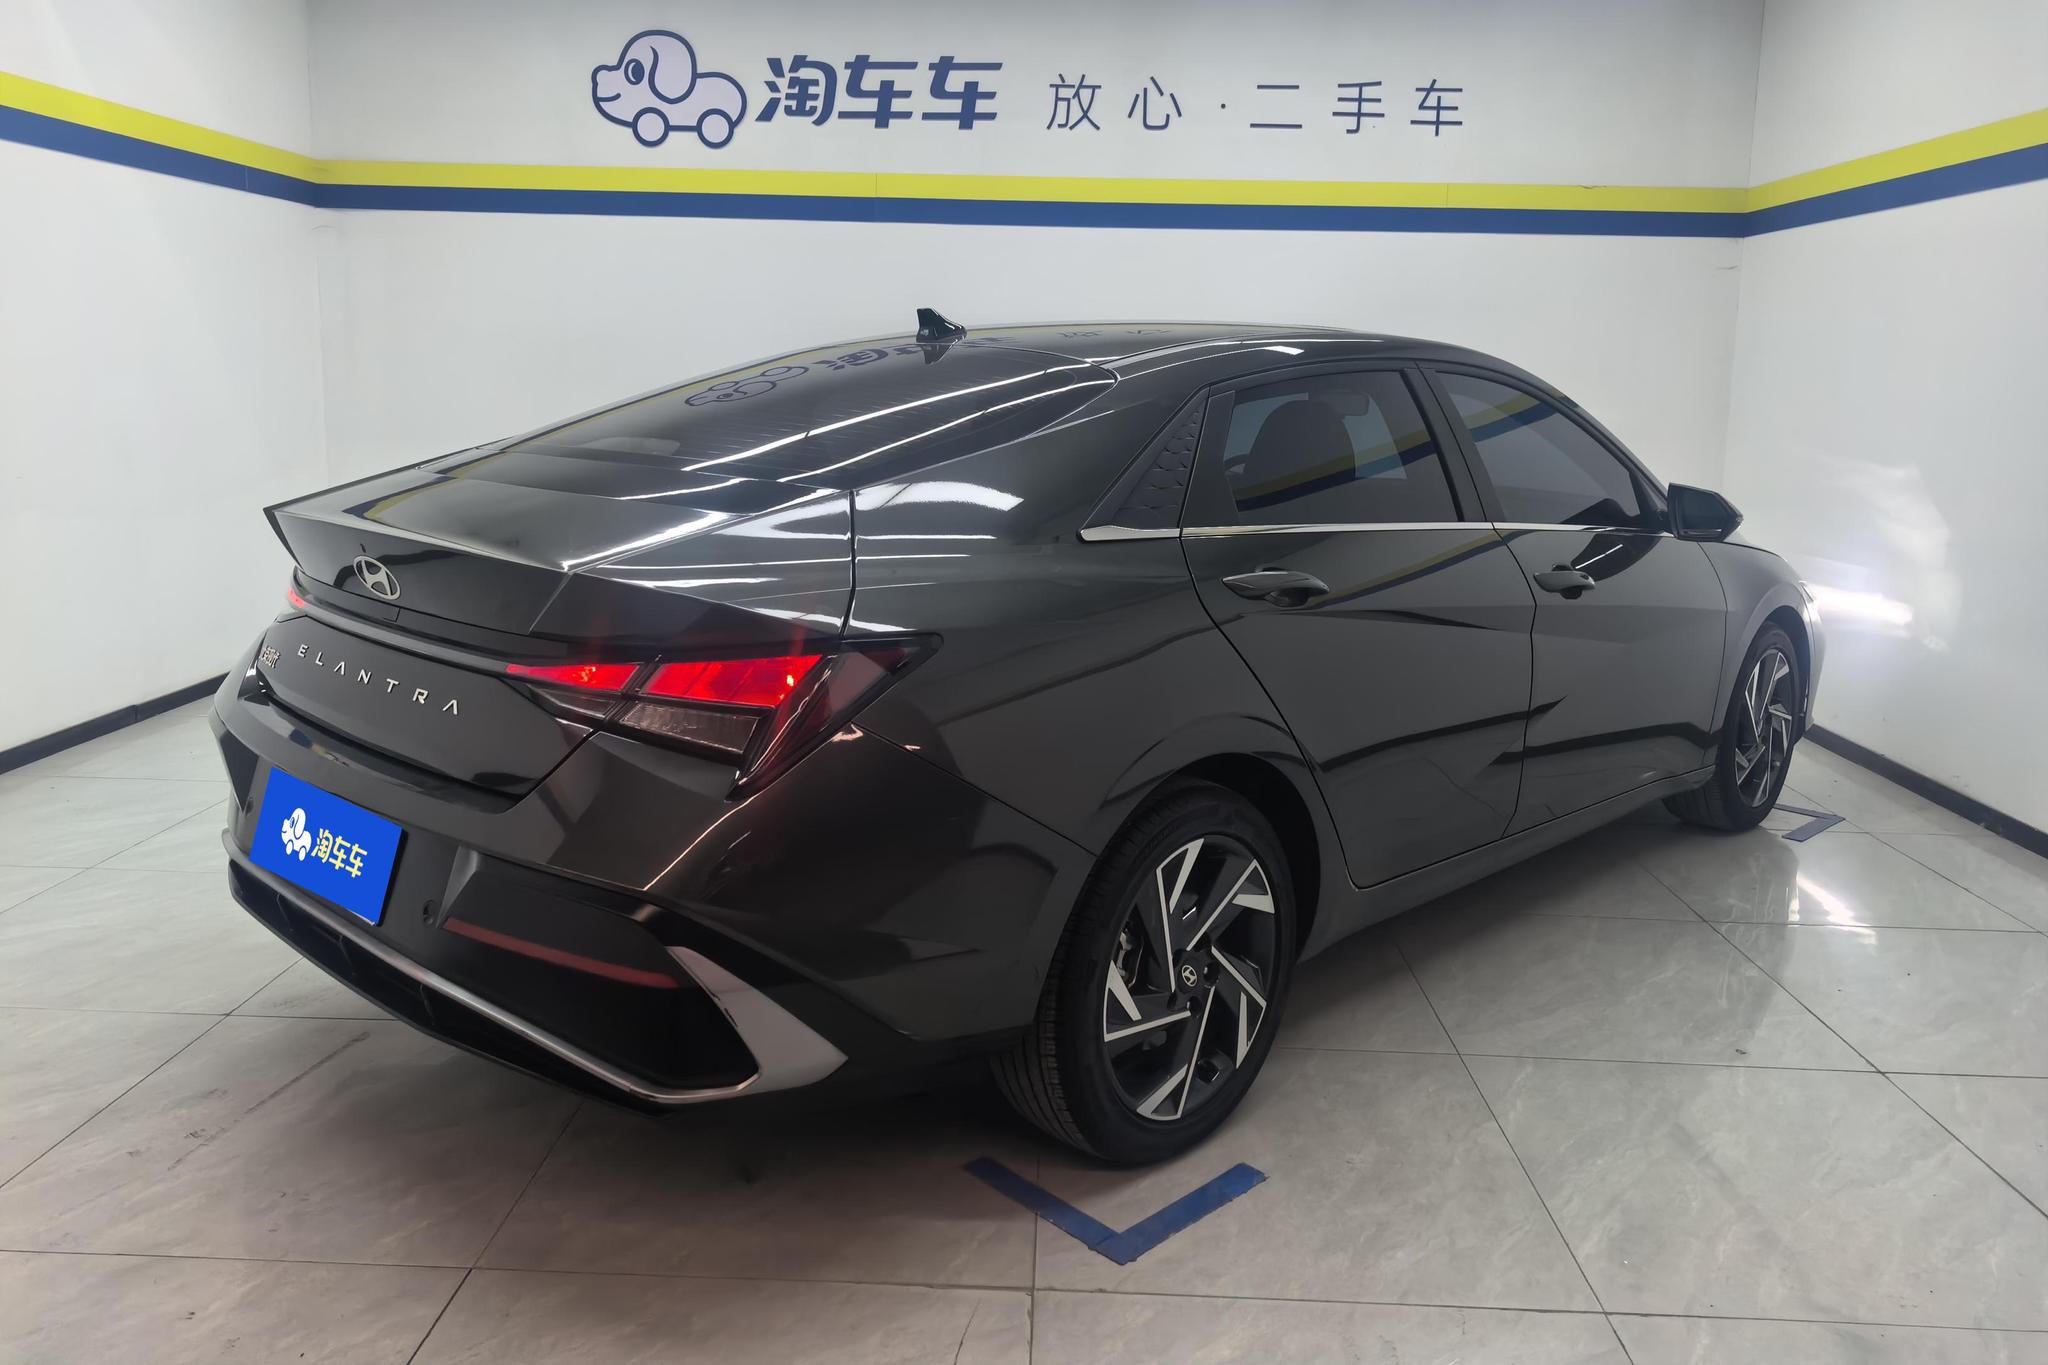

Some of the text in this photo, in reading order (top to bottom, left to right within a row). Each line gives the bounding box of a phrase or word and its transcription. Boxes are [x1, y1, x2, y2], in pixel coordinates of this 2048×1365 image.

[754, 54, 1004, 131] 淘车车
[297, 643, 459, 715] ELANTRA
